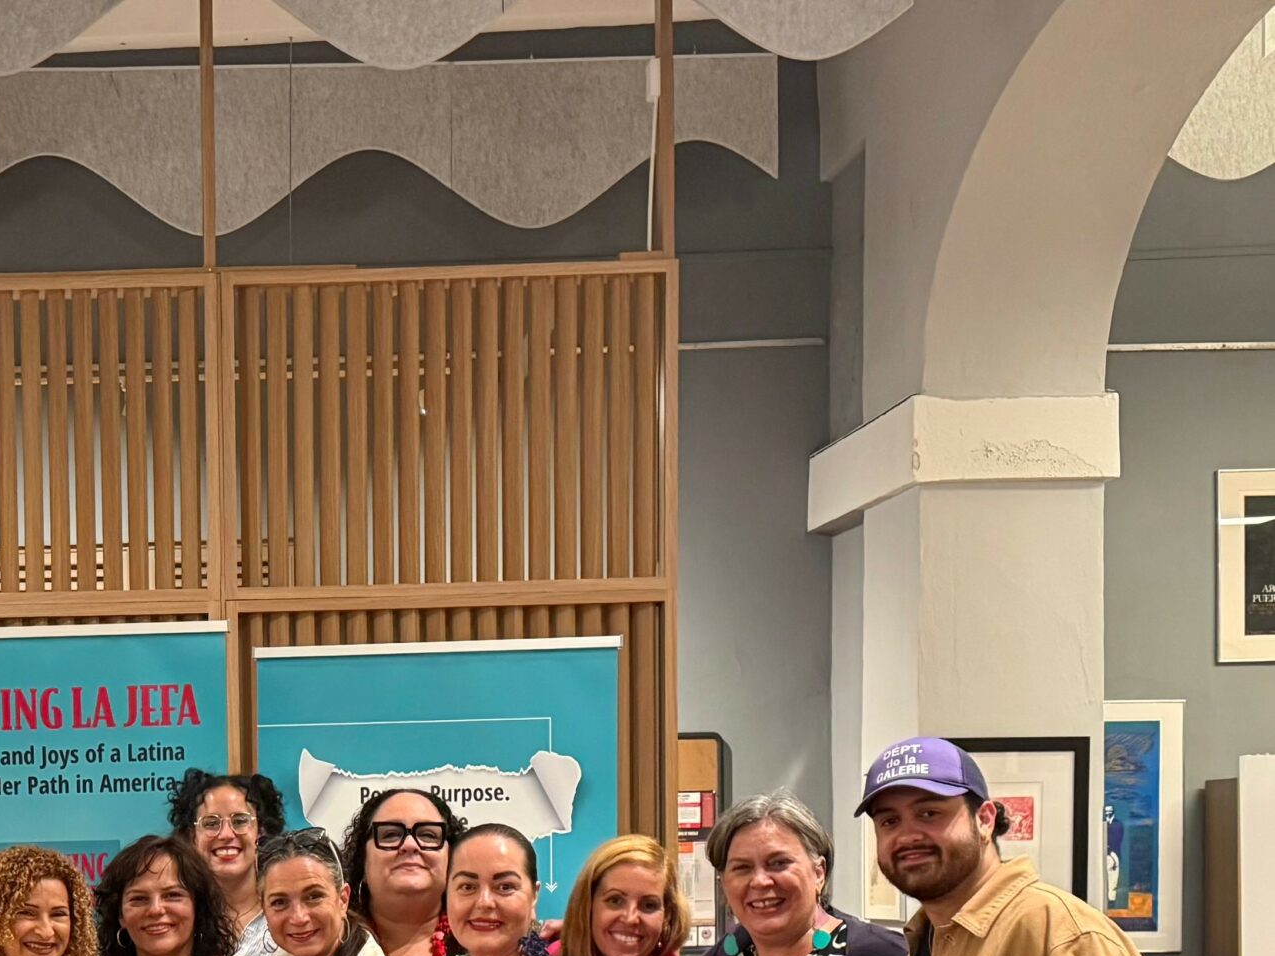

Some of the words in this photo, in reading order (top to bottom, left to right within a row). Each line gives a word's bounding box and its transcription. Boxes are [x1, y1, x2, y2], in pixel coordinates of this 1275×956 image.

[71, 686, 116, 729] LA
[124, 684, 201, 728] JEFA
[0, 745, 35, 766] and
[39, 745, 79, 769] Joys
[85, 743, 105, 763] of
[110, 746, 121, 763] a
[128, 742, 185, 762] Latina
[28, 775, 70, 795] Path
[76, 773, 94, 794] in
[100, 772, 176, 793] America
[876, 763, 929, 784] GALERIE
[431, 785, 510, 807] Purpose.
